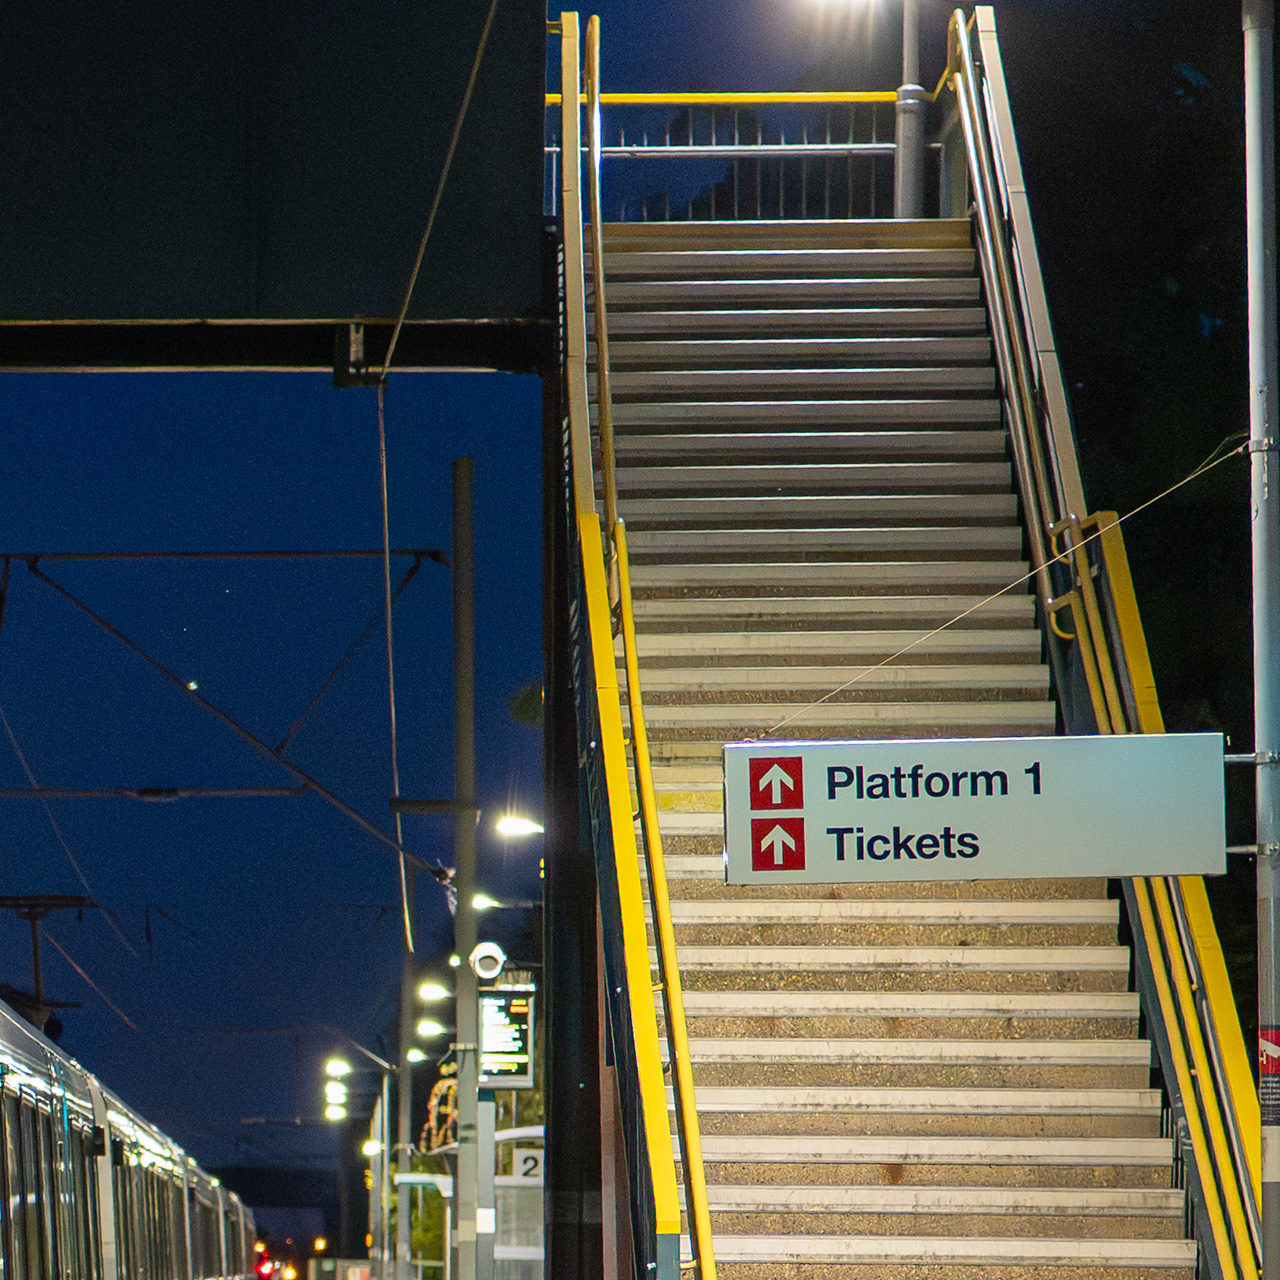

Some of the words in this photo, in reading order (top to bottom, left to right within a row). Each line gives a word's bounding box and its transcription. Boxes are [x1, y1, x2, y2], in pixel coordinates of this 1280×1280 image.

[826, 764, 1009, 800] Platform
[1024, 762, 1043, 796] 1
[826, 826, 980, 861] Tickets
[522, 1156, 539, 1177] 2
